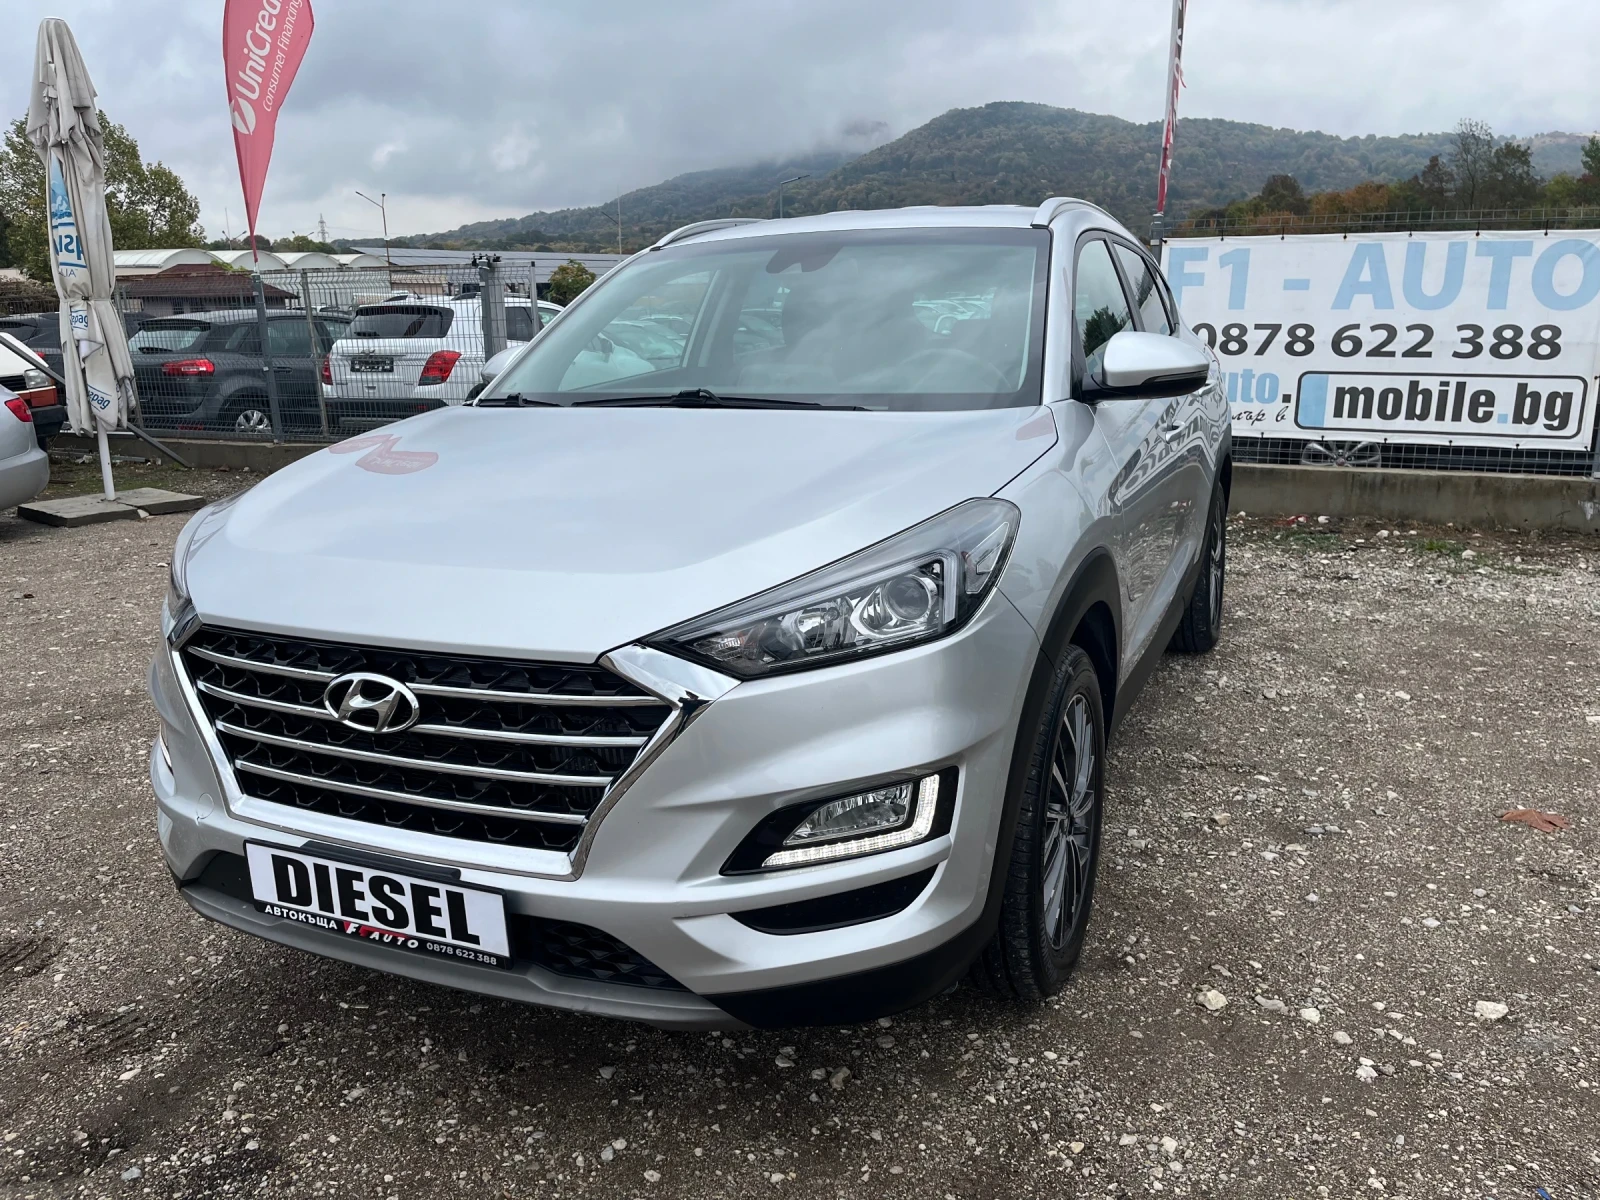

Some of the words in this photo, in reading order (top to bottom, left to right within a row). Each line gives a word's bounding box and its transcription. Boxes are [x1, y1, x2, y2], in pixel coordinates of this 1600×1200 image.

[263, 49, 286, 112] Consumer
[1167, 246, 1251, 310] F1
[1331, 239, 1600, 311] AUTO
[1191, 322, 1315, 357] 0878
[1331, 323, 1434, 358] 622
[1452, 324, 1562, 360] 388
[1332, 380, 1574, 431] mobile.bg
[271, 853, 481, 946] DIESEL
[264, 904, 338, 930] АВТОКЪЩА
[369, 931, 419, 949] AUTO
[426, 942, 454, 955] 0878
[455, 948, 475, 960] 622
[476, 953, 497, 966] 388
